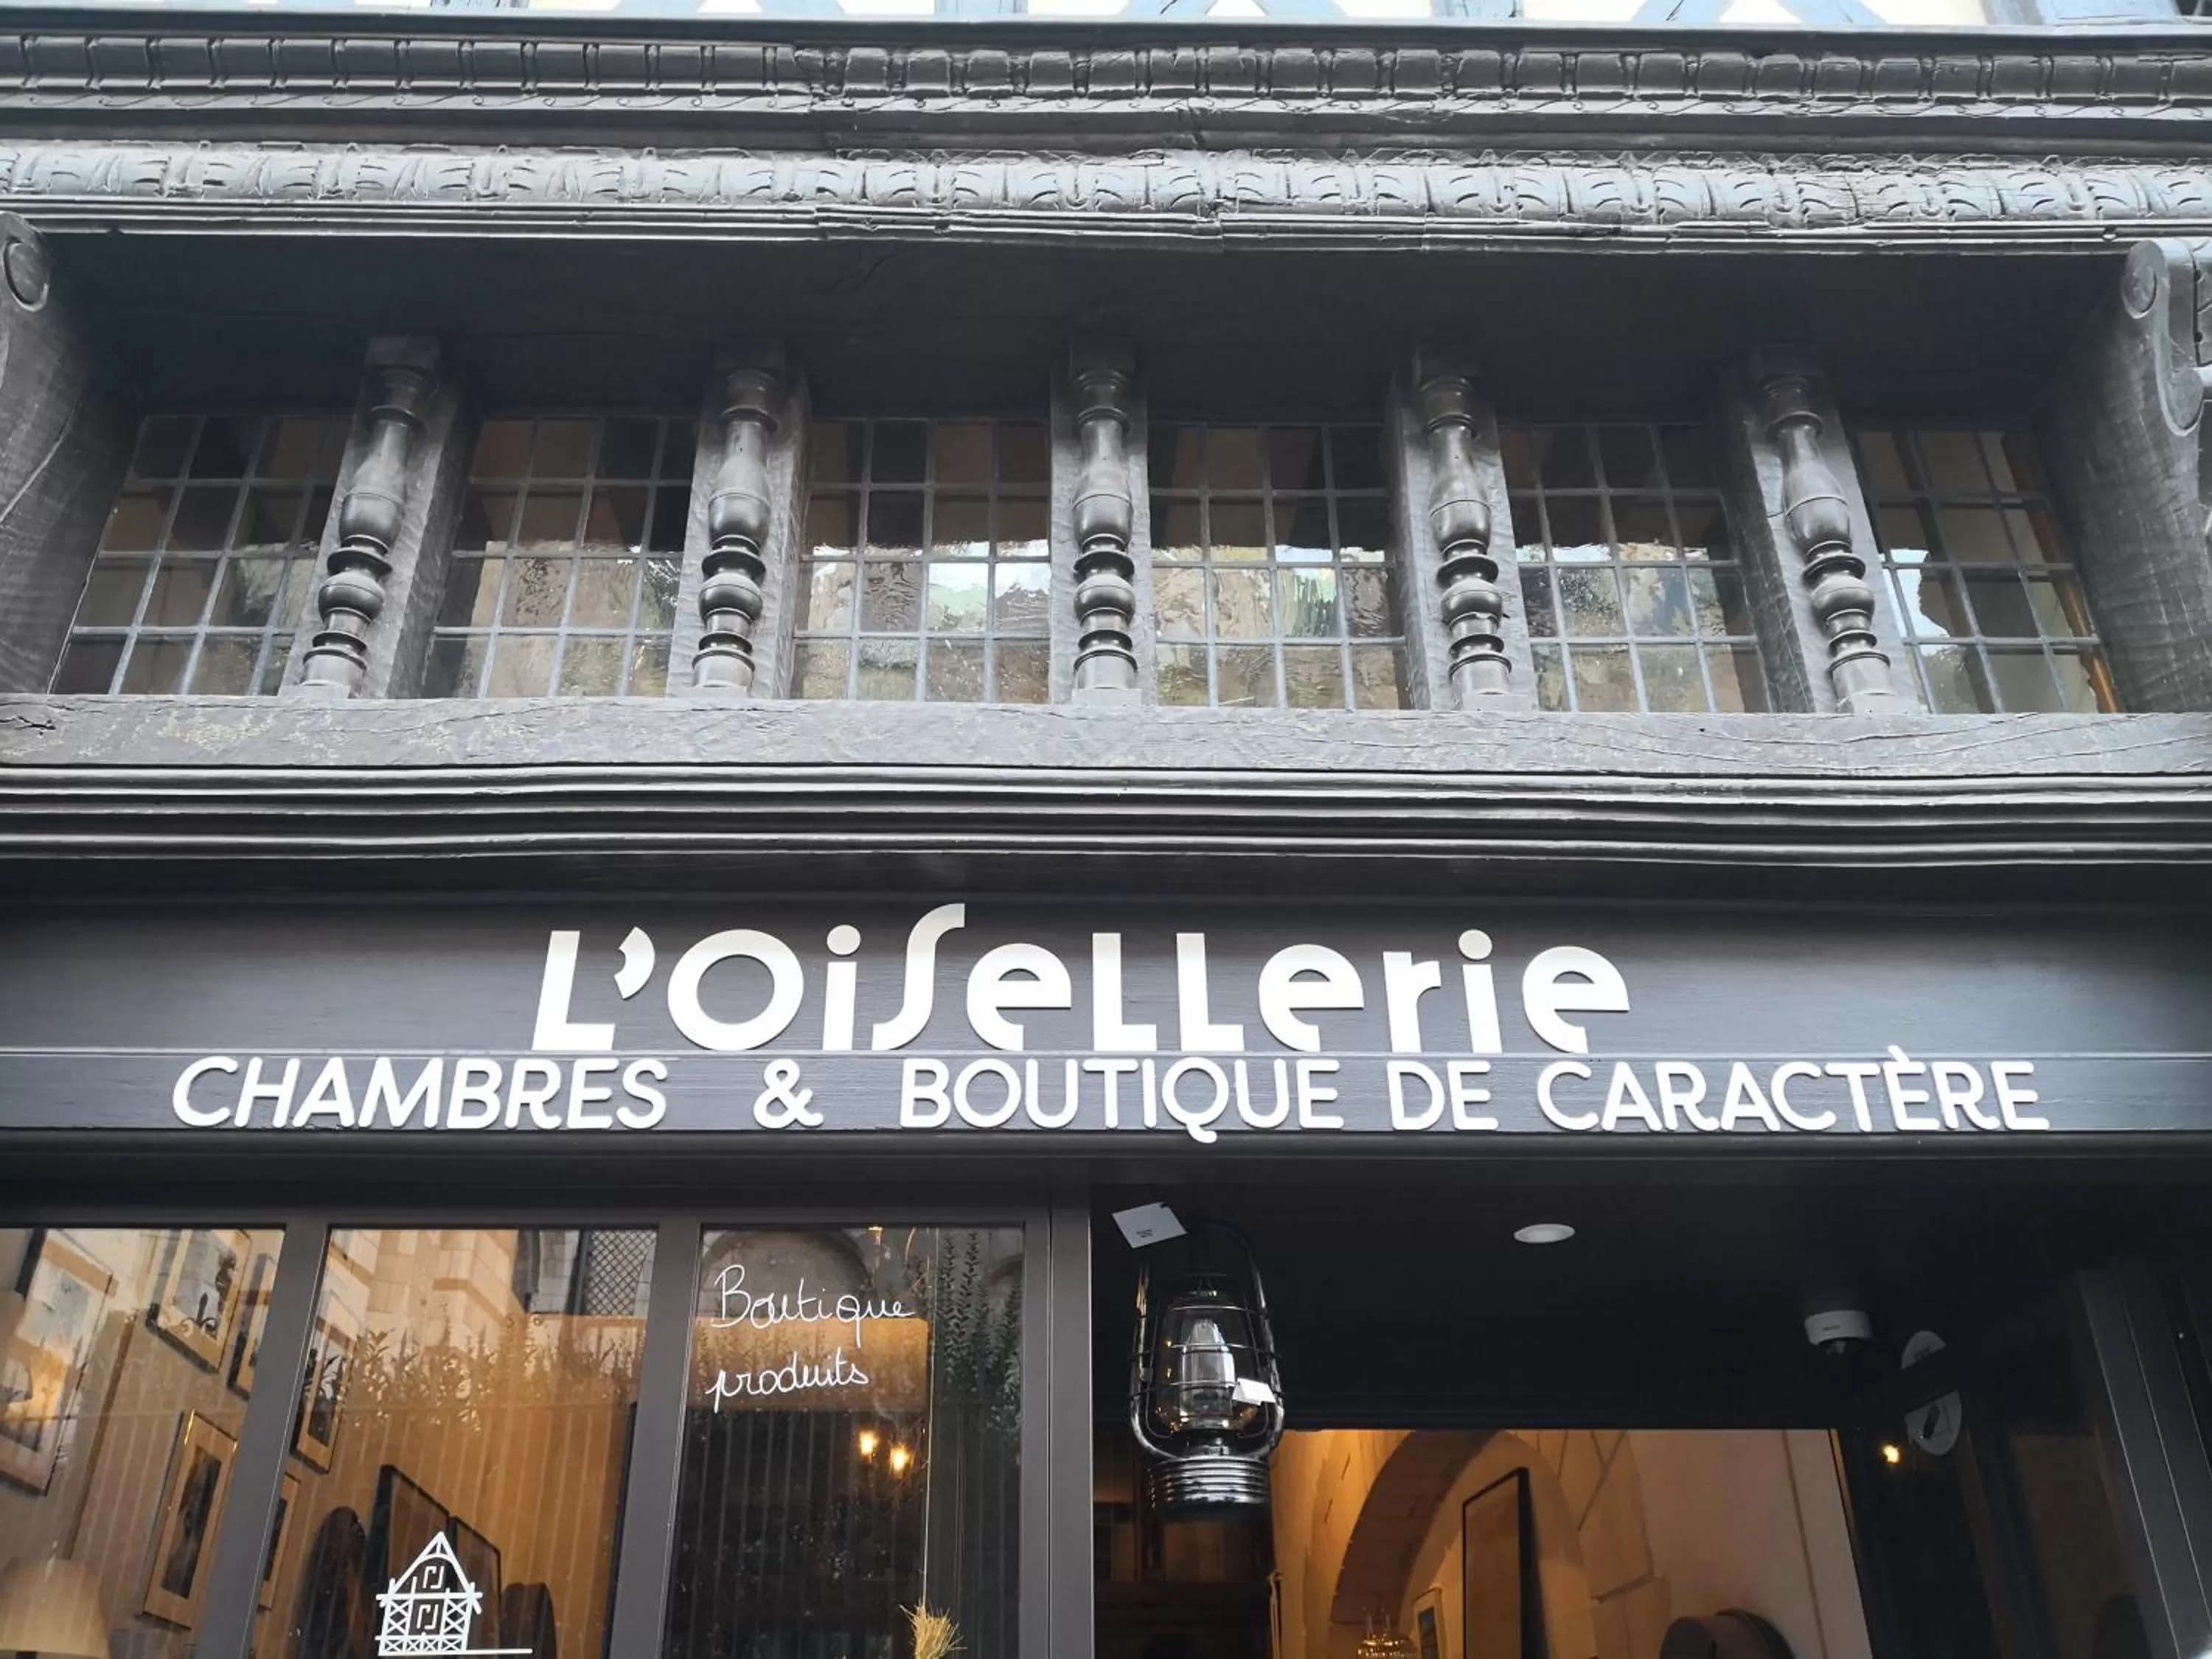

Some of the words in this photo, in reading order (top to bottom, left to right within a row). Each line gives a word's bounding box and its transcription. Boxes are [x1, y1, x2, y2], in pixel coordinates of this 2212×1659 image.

[173, 1056, 668, 1130] CHAMBRES
[754, 1059, 824, 1129] &
[899, 1057, 1345, 1144] BOUTIQUE
[1388, 1060, 1499, 1131] DE
[1537, 1045, 2050, 1133] CARACTÈRE
[711, 1264, 915, 1348] Boutique
[705, 1346, 869, 1413] produits
